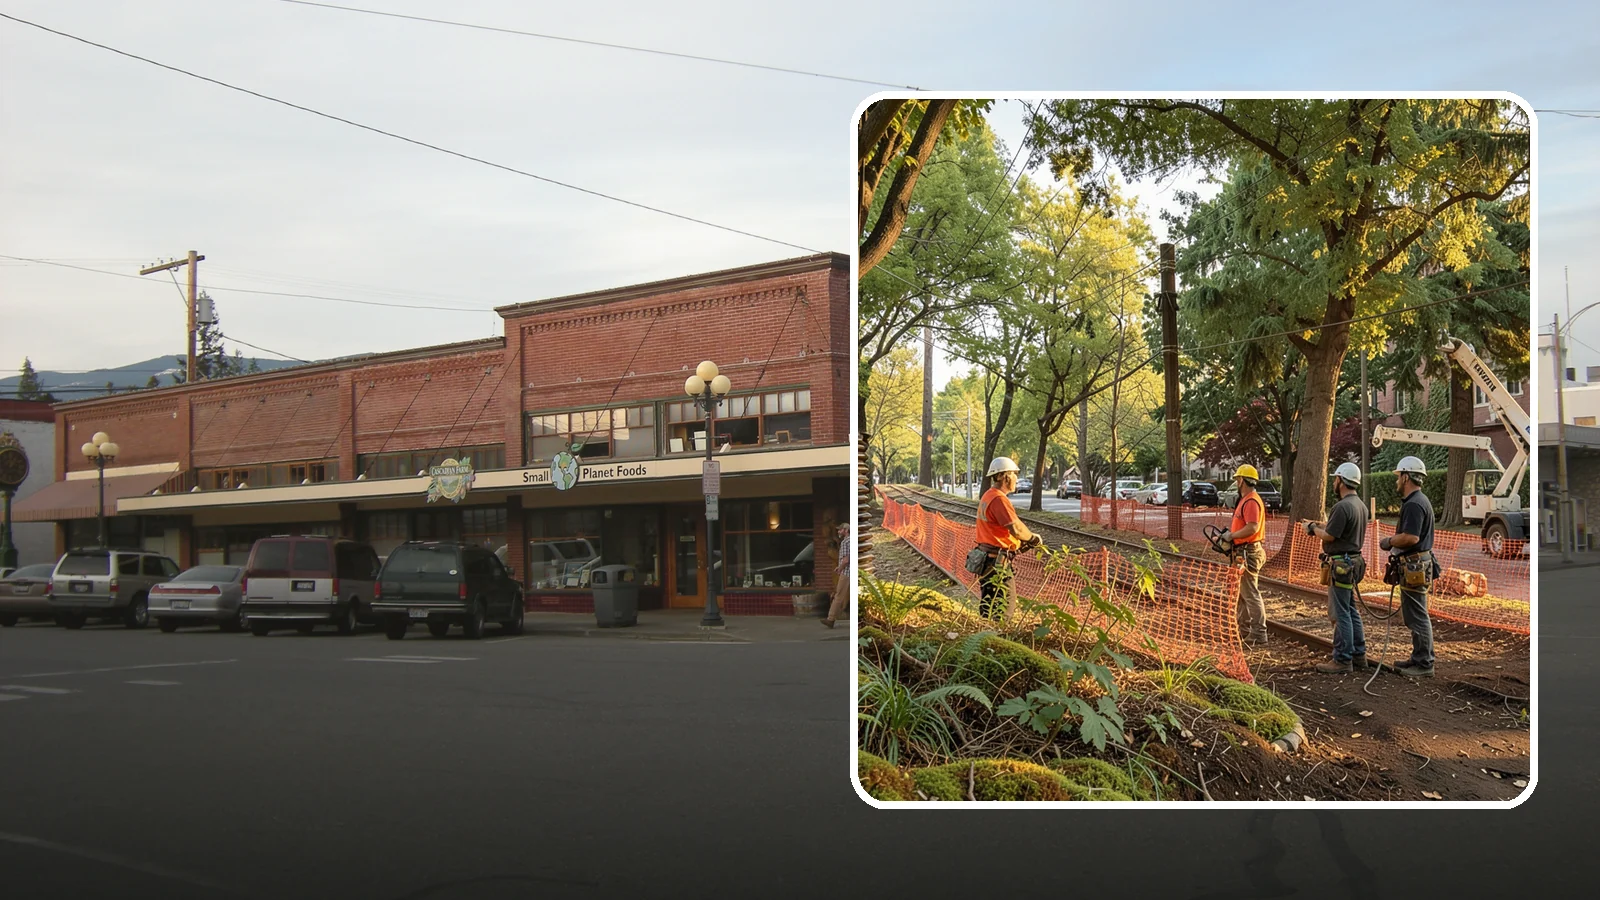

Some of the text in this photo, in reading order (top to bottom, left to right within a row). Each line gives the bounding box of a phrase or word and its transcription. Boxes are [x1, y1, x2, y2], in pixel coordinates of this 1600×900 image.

[523, 464, 647, 483] Small Planet Foods
